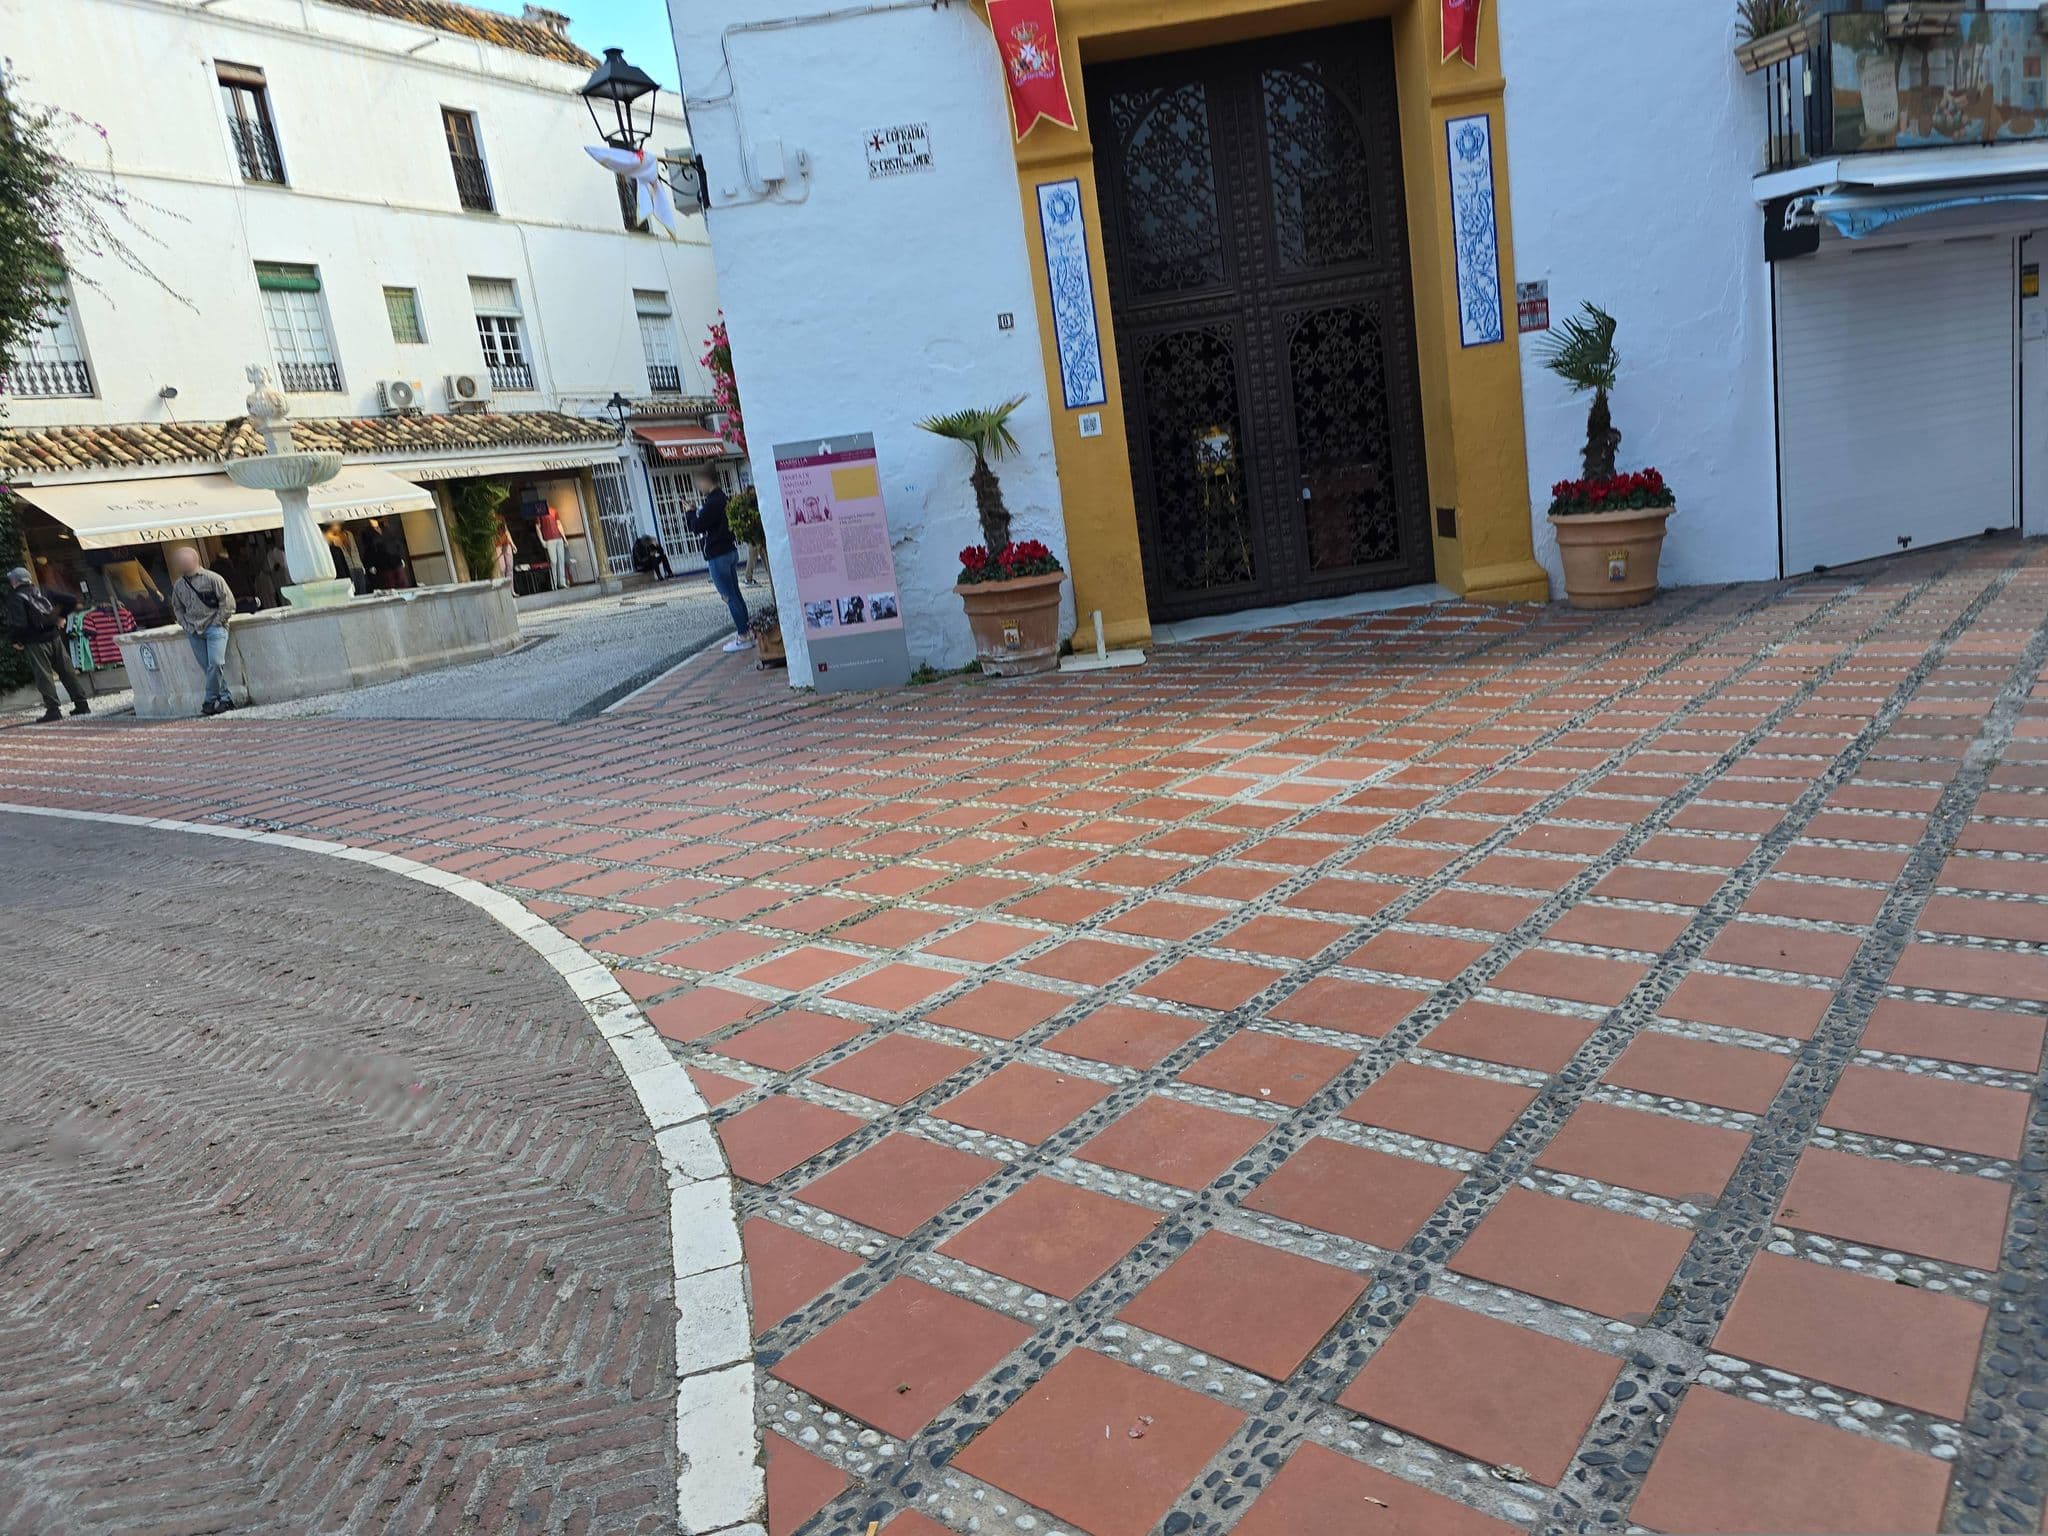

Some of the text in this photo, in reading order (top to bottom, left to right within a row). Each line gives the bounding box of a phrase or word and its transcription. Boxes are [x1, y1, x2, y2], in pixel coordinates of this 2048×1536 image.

[897, 142, 916, 155] DEL
[660, 444, 723, 458] BAR CAFETERIA
[542, 457, 594, 470] BAILEYS
[419, 465, 481, 481] BAILEYS
[138, 521, 229, 542] BAILEYS
